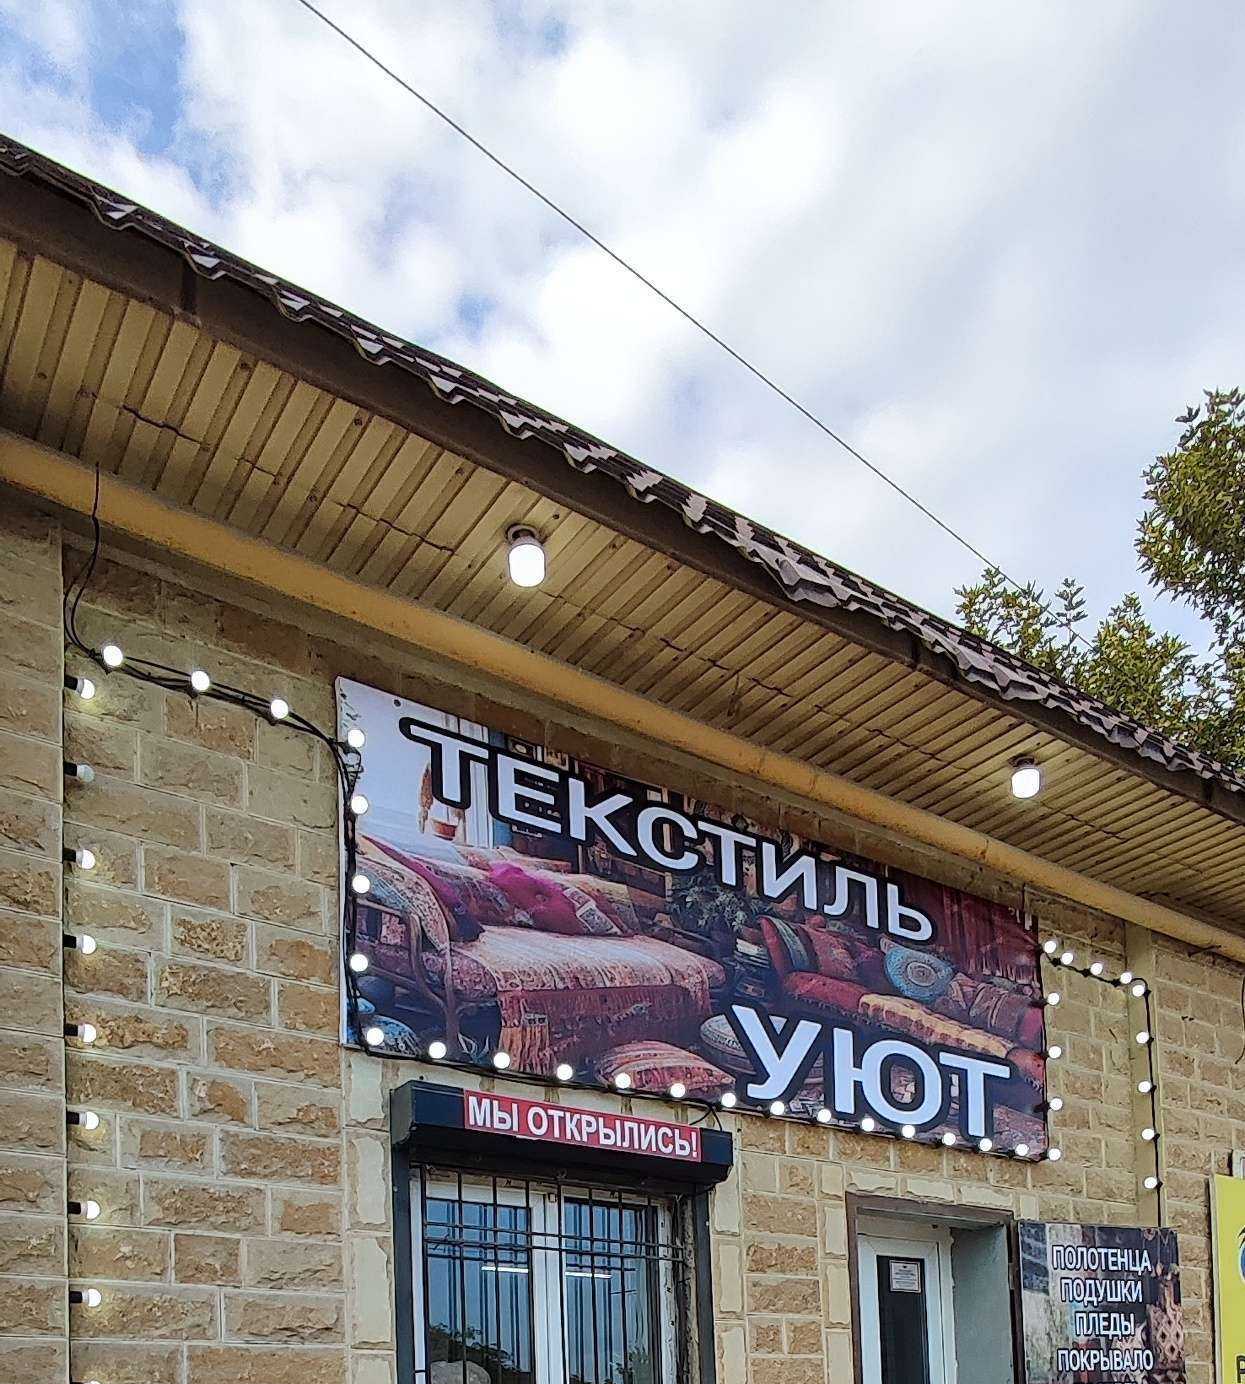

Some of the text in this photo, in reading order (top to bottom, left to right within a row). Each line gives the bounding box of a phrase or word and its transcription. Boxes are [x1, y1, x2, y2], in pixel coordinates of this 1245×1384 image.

[409, 722, 934, 943] ТЕКСТИЛЬ
[732, 1004, 1011, 1138] УЮТ
[467, 1096, 698, 1157] МЫ ОТКРЫЛИСЬ!
[1052, 1245, 1152, 1274] ПОЛОТЕНЦА
[1060, 1277, 1143, 1304] ПОДУШКИ
[1075, 1312, 1135, 1338] ПЛЕДЫ
[1057, 1349, 1154, 1372] ПОКРЫВАЛО
